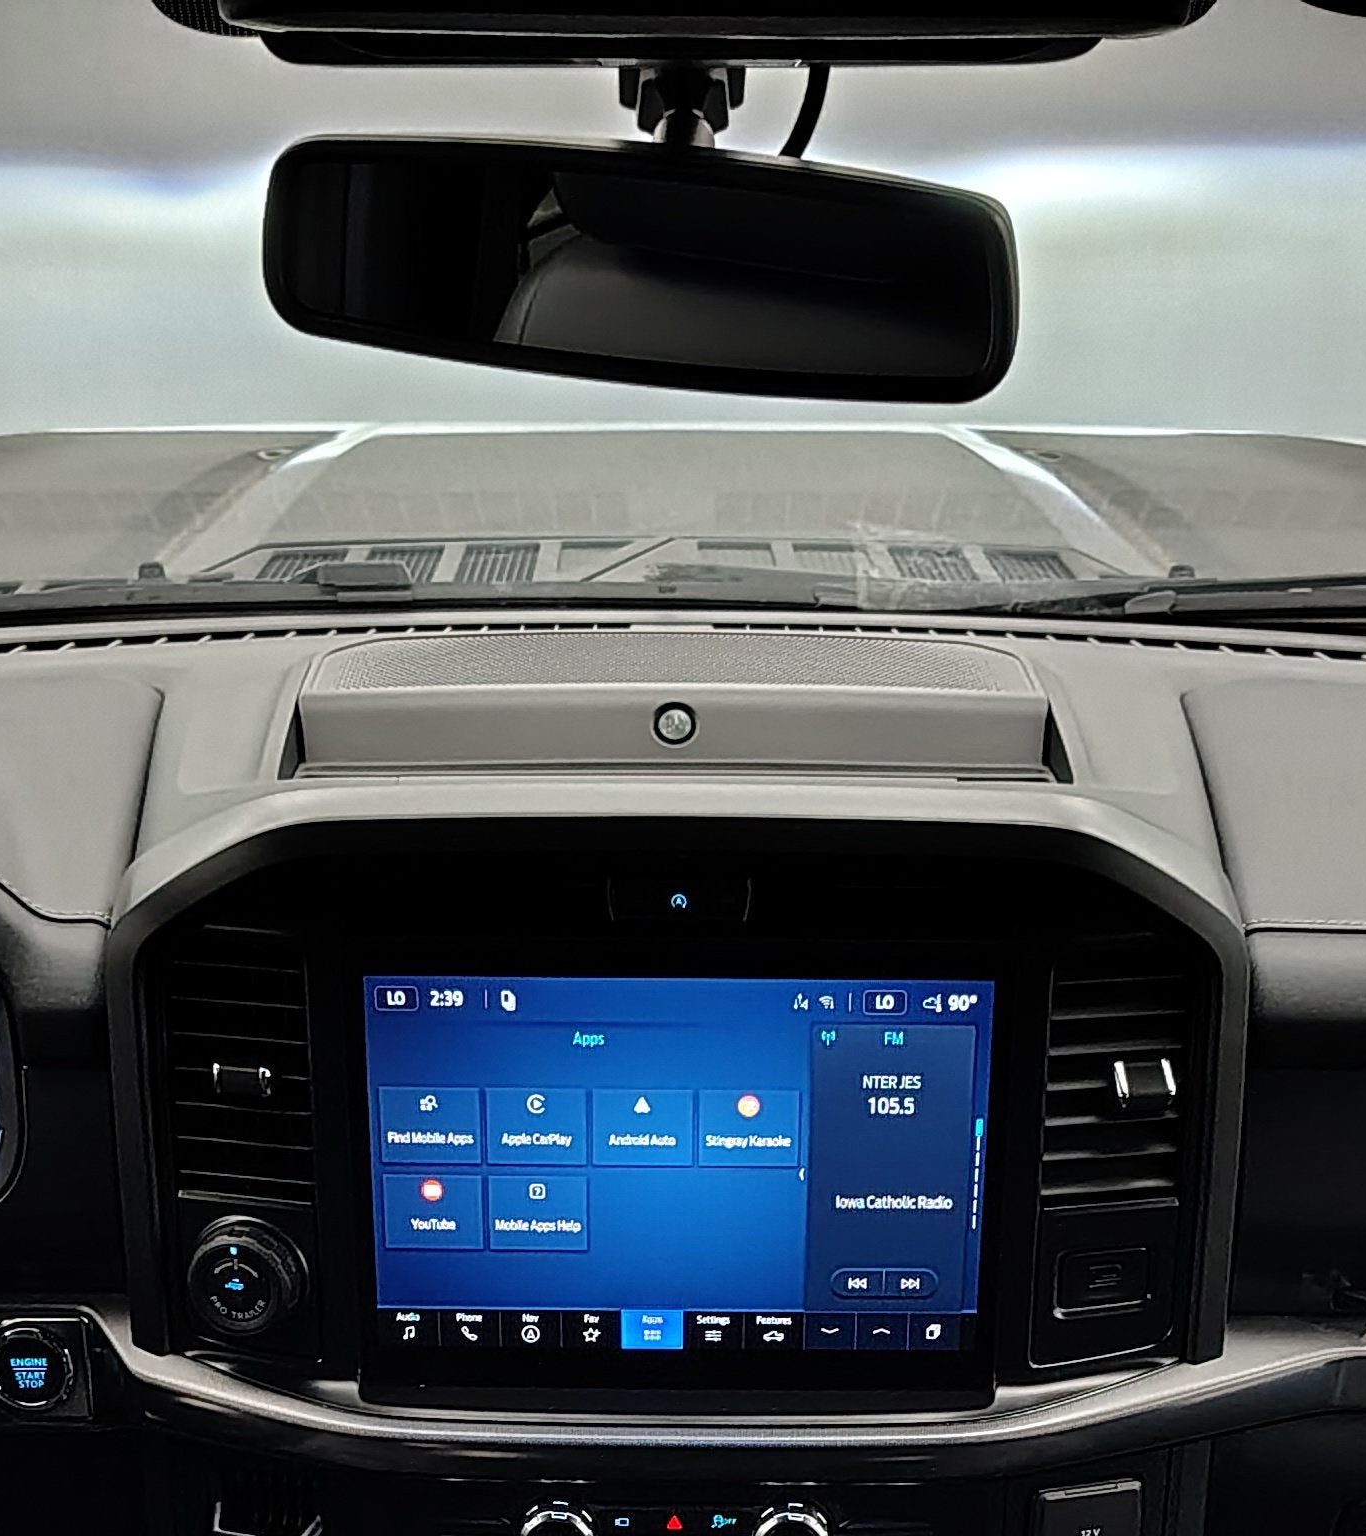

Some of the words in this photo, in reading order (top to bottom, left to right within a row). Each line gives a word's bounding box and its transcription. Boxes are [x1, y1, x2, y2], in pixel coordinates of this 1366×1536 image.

[387, 990, 406, 1005] LO
[429, 990, 464, 1006] 2:39
[875, 994, 895, 1010] LO
[947, 994, 978, 1011] 90°
[573, 1031, 605, 1048] Apps
[885, 1031, 904, 1046] FM
[862, 1075, 897, 1089] NTER
[899, 1076, 922, 1089] JES
[867, 1097, 915, 1115] 105.5
[387, 1131, 410, 1144] Find
[412, 1132, 445, 1144] Mobile
[447, 1132, 474, 1146] Apps
[501, 1133, 532, 1147] Apple
[533, 1133, 572, 1148] CarPlay
[609, 1134, 649, 1146] Android
[650, 1134, 676, 1146] Auto
[705, 1135, 748, 1149] Stingray
[749, 1135, 791, 1148] Karaoke
[835, 1195, 865, 1209] Iowa
[867, 1195, 916, 1209] Catholic
[917, 1195, 953, 1210] Radio
[411, 1218, 456, 1231] YouTube
[495, 1219, 529, 1231] Mobile
[530, 1220, 556, 1233] Apps
[557, 1220, 582, 1233] Help
[210, 1296, 228, 1315] PRO
[231, 1300, 267, 1320] TRAILER
[396, 1312, 421, 1322] Audio
[456, 1313, 483, 1322] Phone
[522, 1314, 540, 1323] Nav
[583, 1314, 600, 1324] Fav
[696, 1315, 731, 1326] Settings
[756, 1316, 792, 1325] Features
[10, 1357, 48, 1367] ENGINE
[15, 1372, 46, 1381] START
[18, 1380, 45, 1389] STOP
[1092, 1528, 1101, 1536] V
